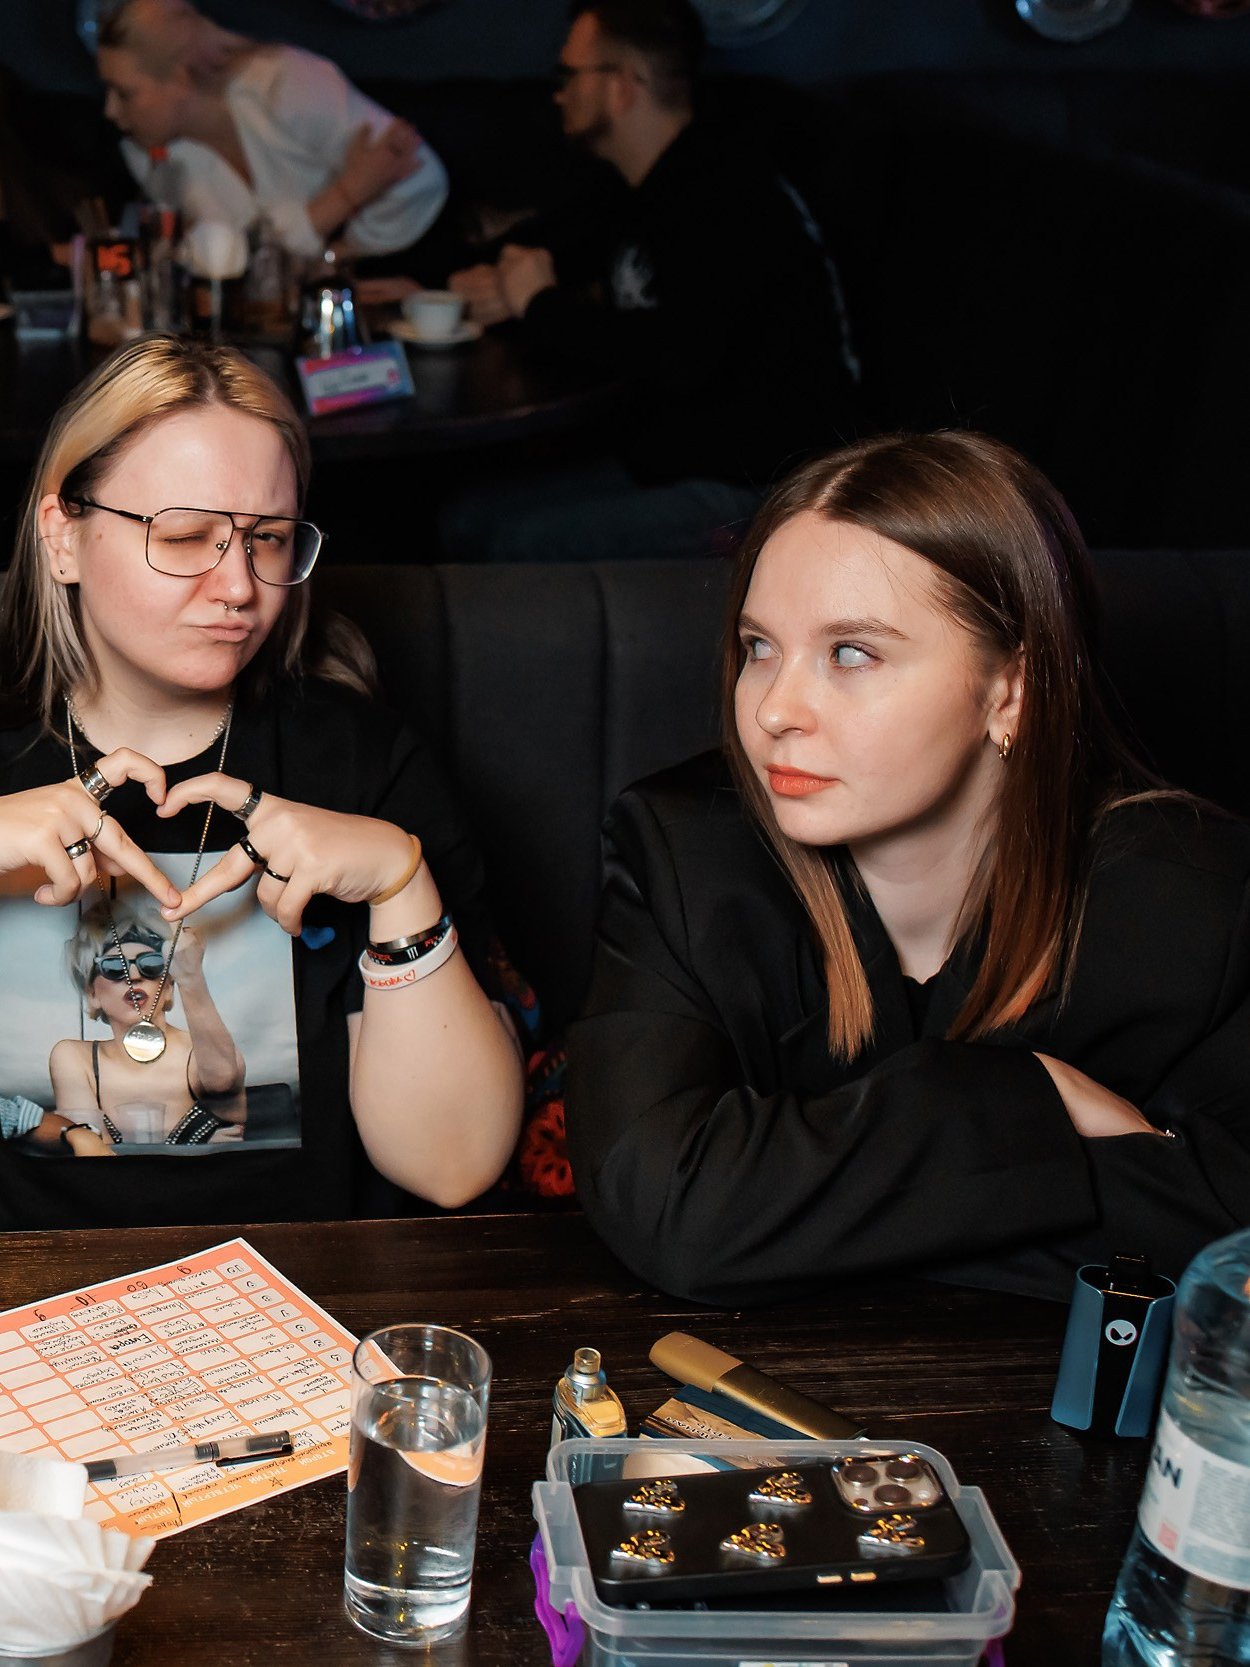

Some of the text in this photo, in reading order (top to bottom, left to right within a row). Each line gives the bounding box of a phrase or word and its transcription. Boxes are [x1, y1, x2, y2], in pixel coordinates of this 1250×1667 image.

[175, 1265, 191, 1275] 9
[225, 1263, 241, 1273] 10
[297, 1448, 337, 1465] ВТОРОЙ
[247, 1466, 287, 1483] ТРЕТИЙ
[180, 1483, 242, 1507] ЧЕТВЕРТЫЙ
[135, 1507, 172, 1524] ПЯТЫЙ
